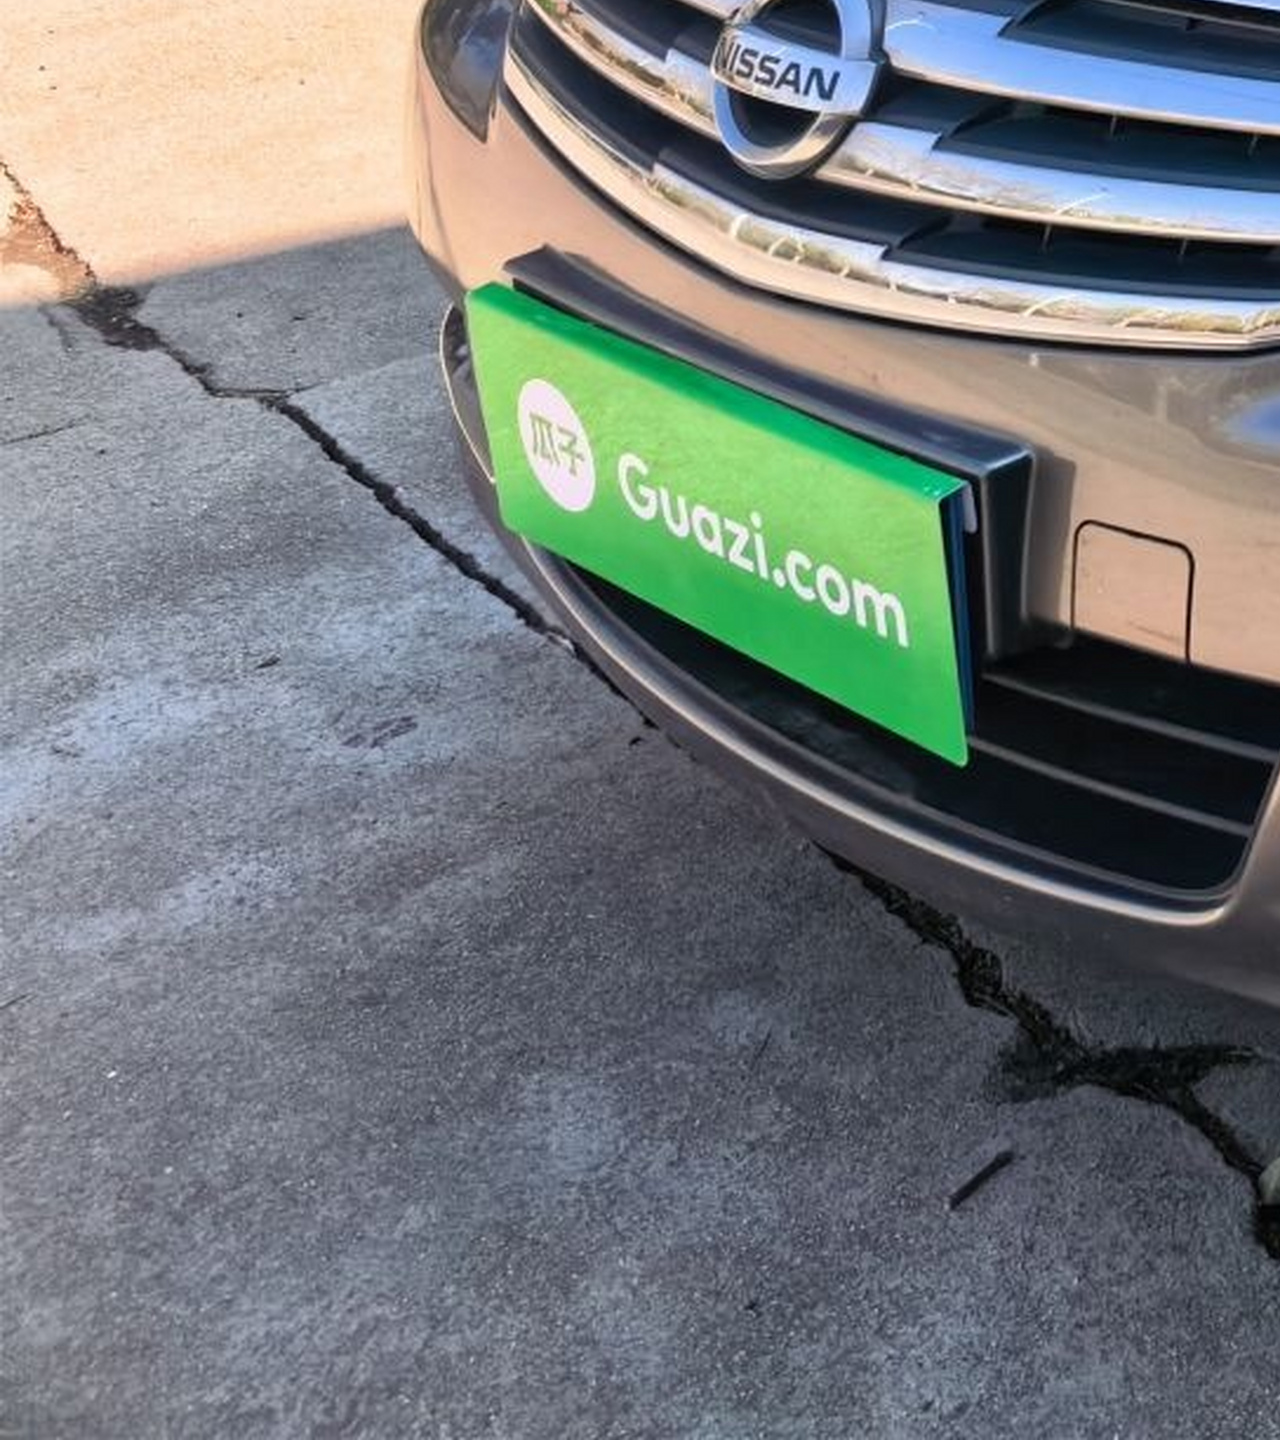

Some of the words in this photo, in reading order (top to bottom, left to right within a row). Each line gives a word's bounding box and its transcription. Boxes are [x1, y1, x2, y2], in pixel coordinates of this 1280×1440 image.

[714, 35, 840, 101] NISSAN
[528, 411, 585, 477] 瓜子
[617, 453, 909, 648] Guazi.com
